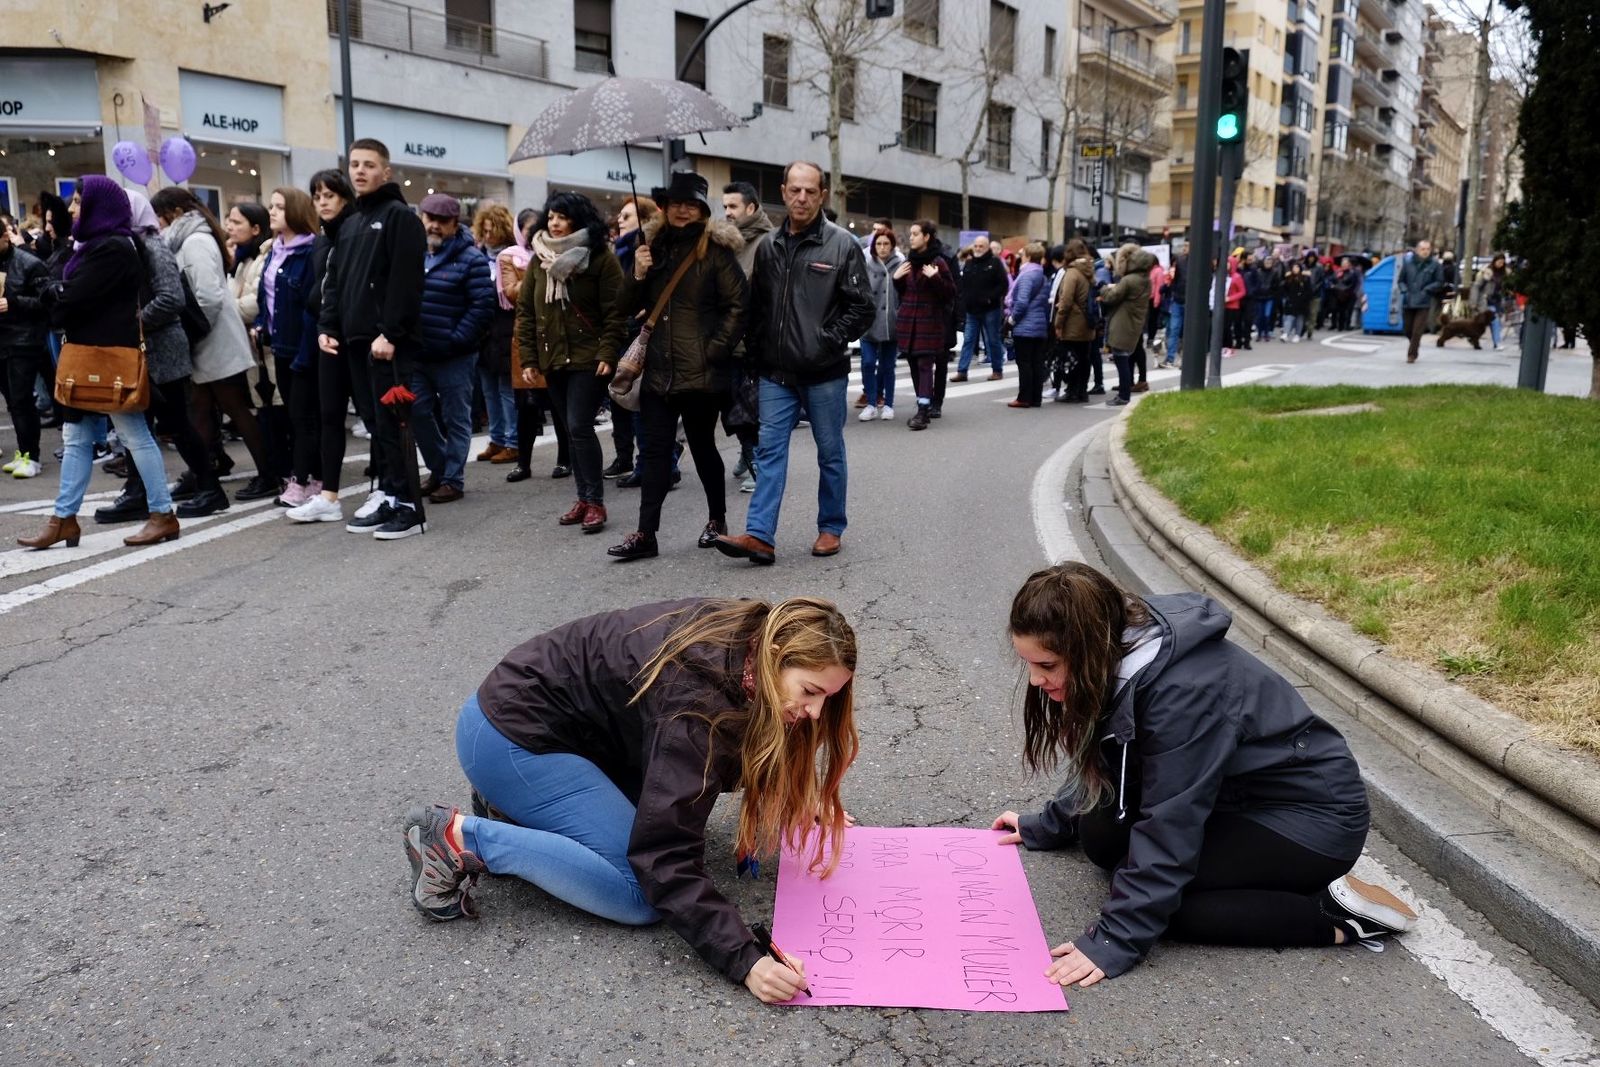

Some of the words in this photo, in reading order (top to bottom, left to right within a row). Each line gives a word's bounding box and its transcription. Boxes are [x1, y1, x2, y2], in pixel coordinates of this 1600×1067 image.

[0, 101, 23, 115] OP
[203, 112, 259, 133] ALE-HOP
[405, 142, 447, 158] ALE-HOP
[1093, 161, 1102, 205] HOSTAL
[872, 837, 909, 870] PARA
[863, 886, 925, 962] MORIR
[956, 934, 1021, 1005] MULLER
